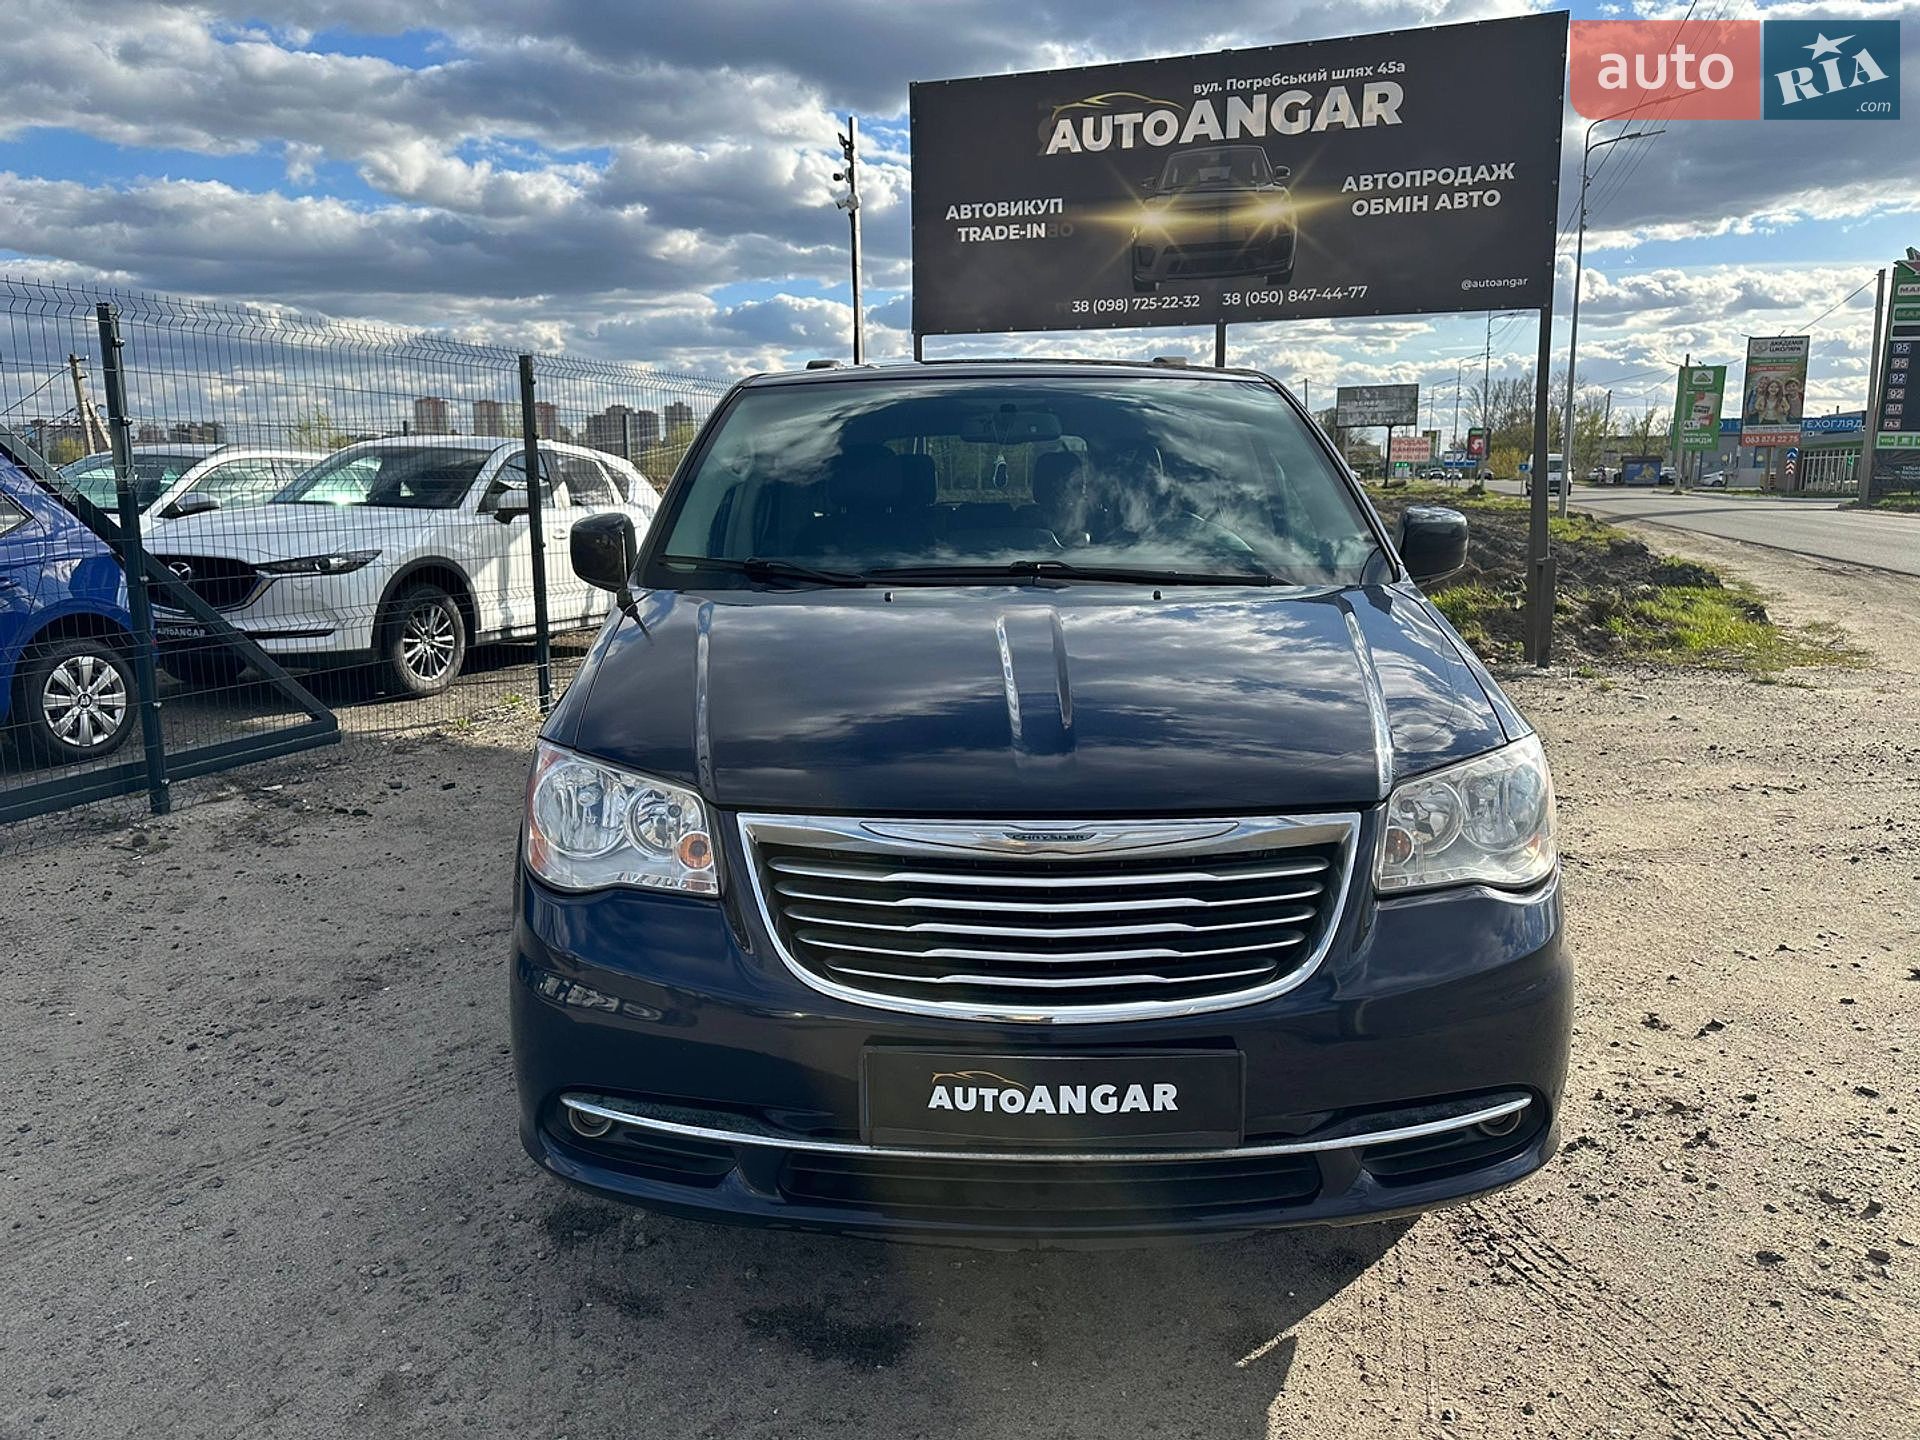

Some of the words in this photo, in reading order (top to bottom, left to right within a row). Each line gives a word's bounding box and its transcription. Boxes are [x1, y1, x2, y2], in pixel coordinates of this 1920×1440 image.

[1193, 80, 1223, 96] вул.
[1226, 68, 1327, 91] Погребський
[1331, 64, 1374, 81] шлях
[1377, 61, 1406, 75] 45а
[1046, 80, 1405, 155] AUTOANGAR
[1341, 162, 1516, 193] АВТОПРОДАЖ
[945, 198, 1063, 220] АВТОВИКУП
[1352, 195, 1428, 217] ОБМІН
[1434, 189, 1501, 211] АВТО
[957, 222, 1046, 242] TRADE-IN
[1461, 278, 1529, 291] @autoangar
[1071, 300, 1090, 313] 38
[1093, 298, 1128, 315] (098)
[1132, 294, 1201, 310] 725-22-32
[1222, 292, 1242, 306] 38
[1245, 290, 1284, 307] (050)
[1288, 285, 1369, 303] 847-44-77
[1801, 418, 1863, 430] ТЕХОГЛЯД
[928, 1083, 1179, 1115] AUTOANGAR
